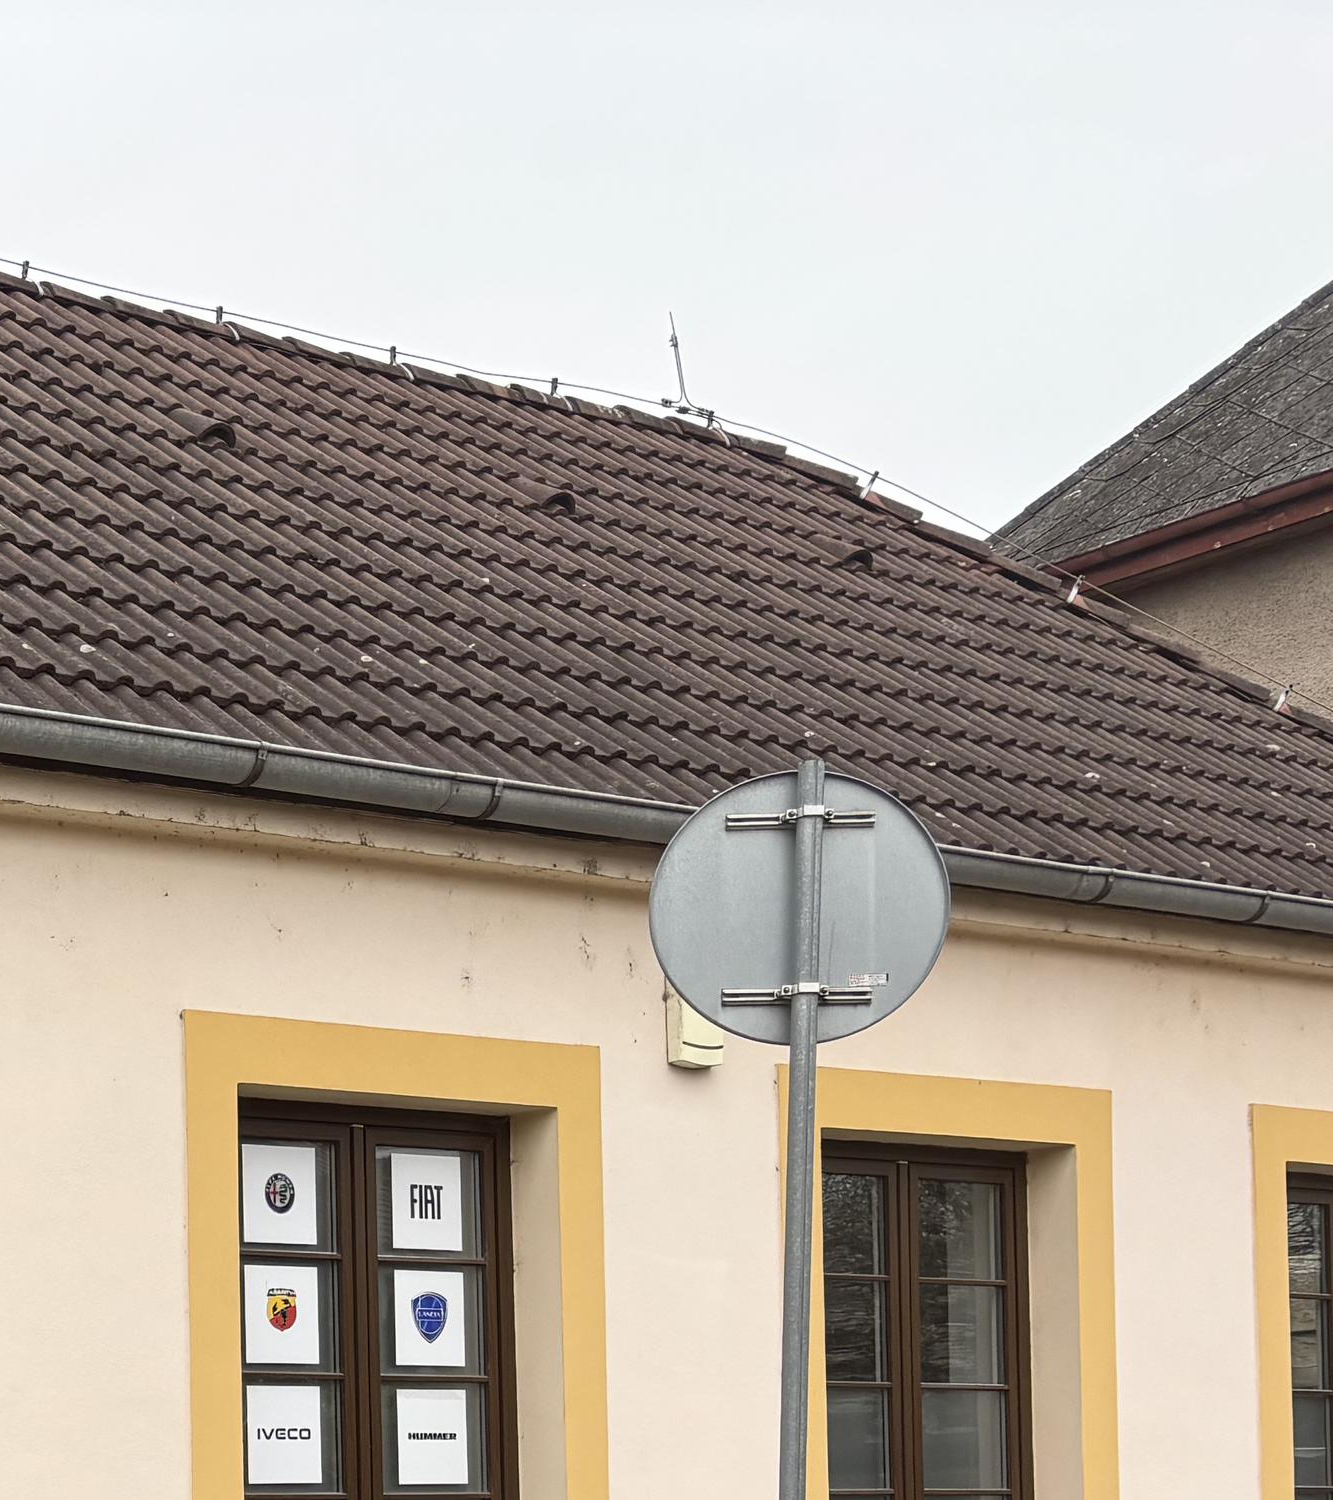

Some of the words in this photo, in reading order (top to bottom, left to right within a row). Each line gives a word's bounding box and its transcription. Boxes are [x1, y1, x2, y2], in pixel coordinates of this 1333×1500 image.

[409, 1184, 444, 1220] FIAT
[256, 1428, 312, 1440] IVECO
[407, 1432, 457, 1441] HUMMER
